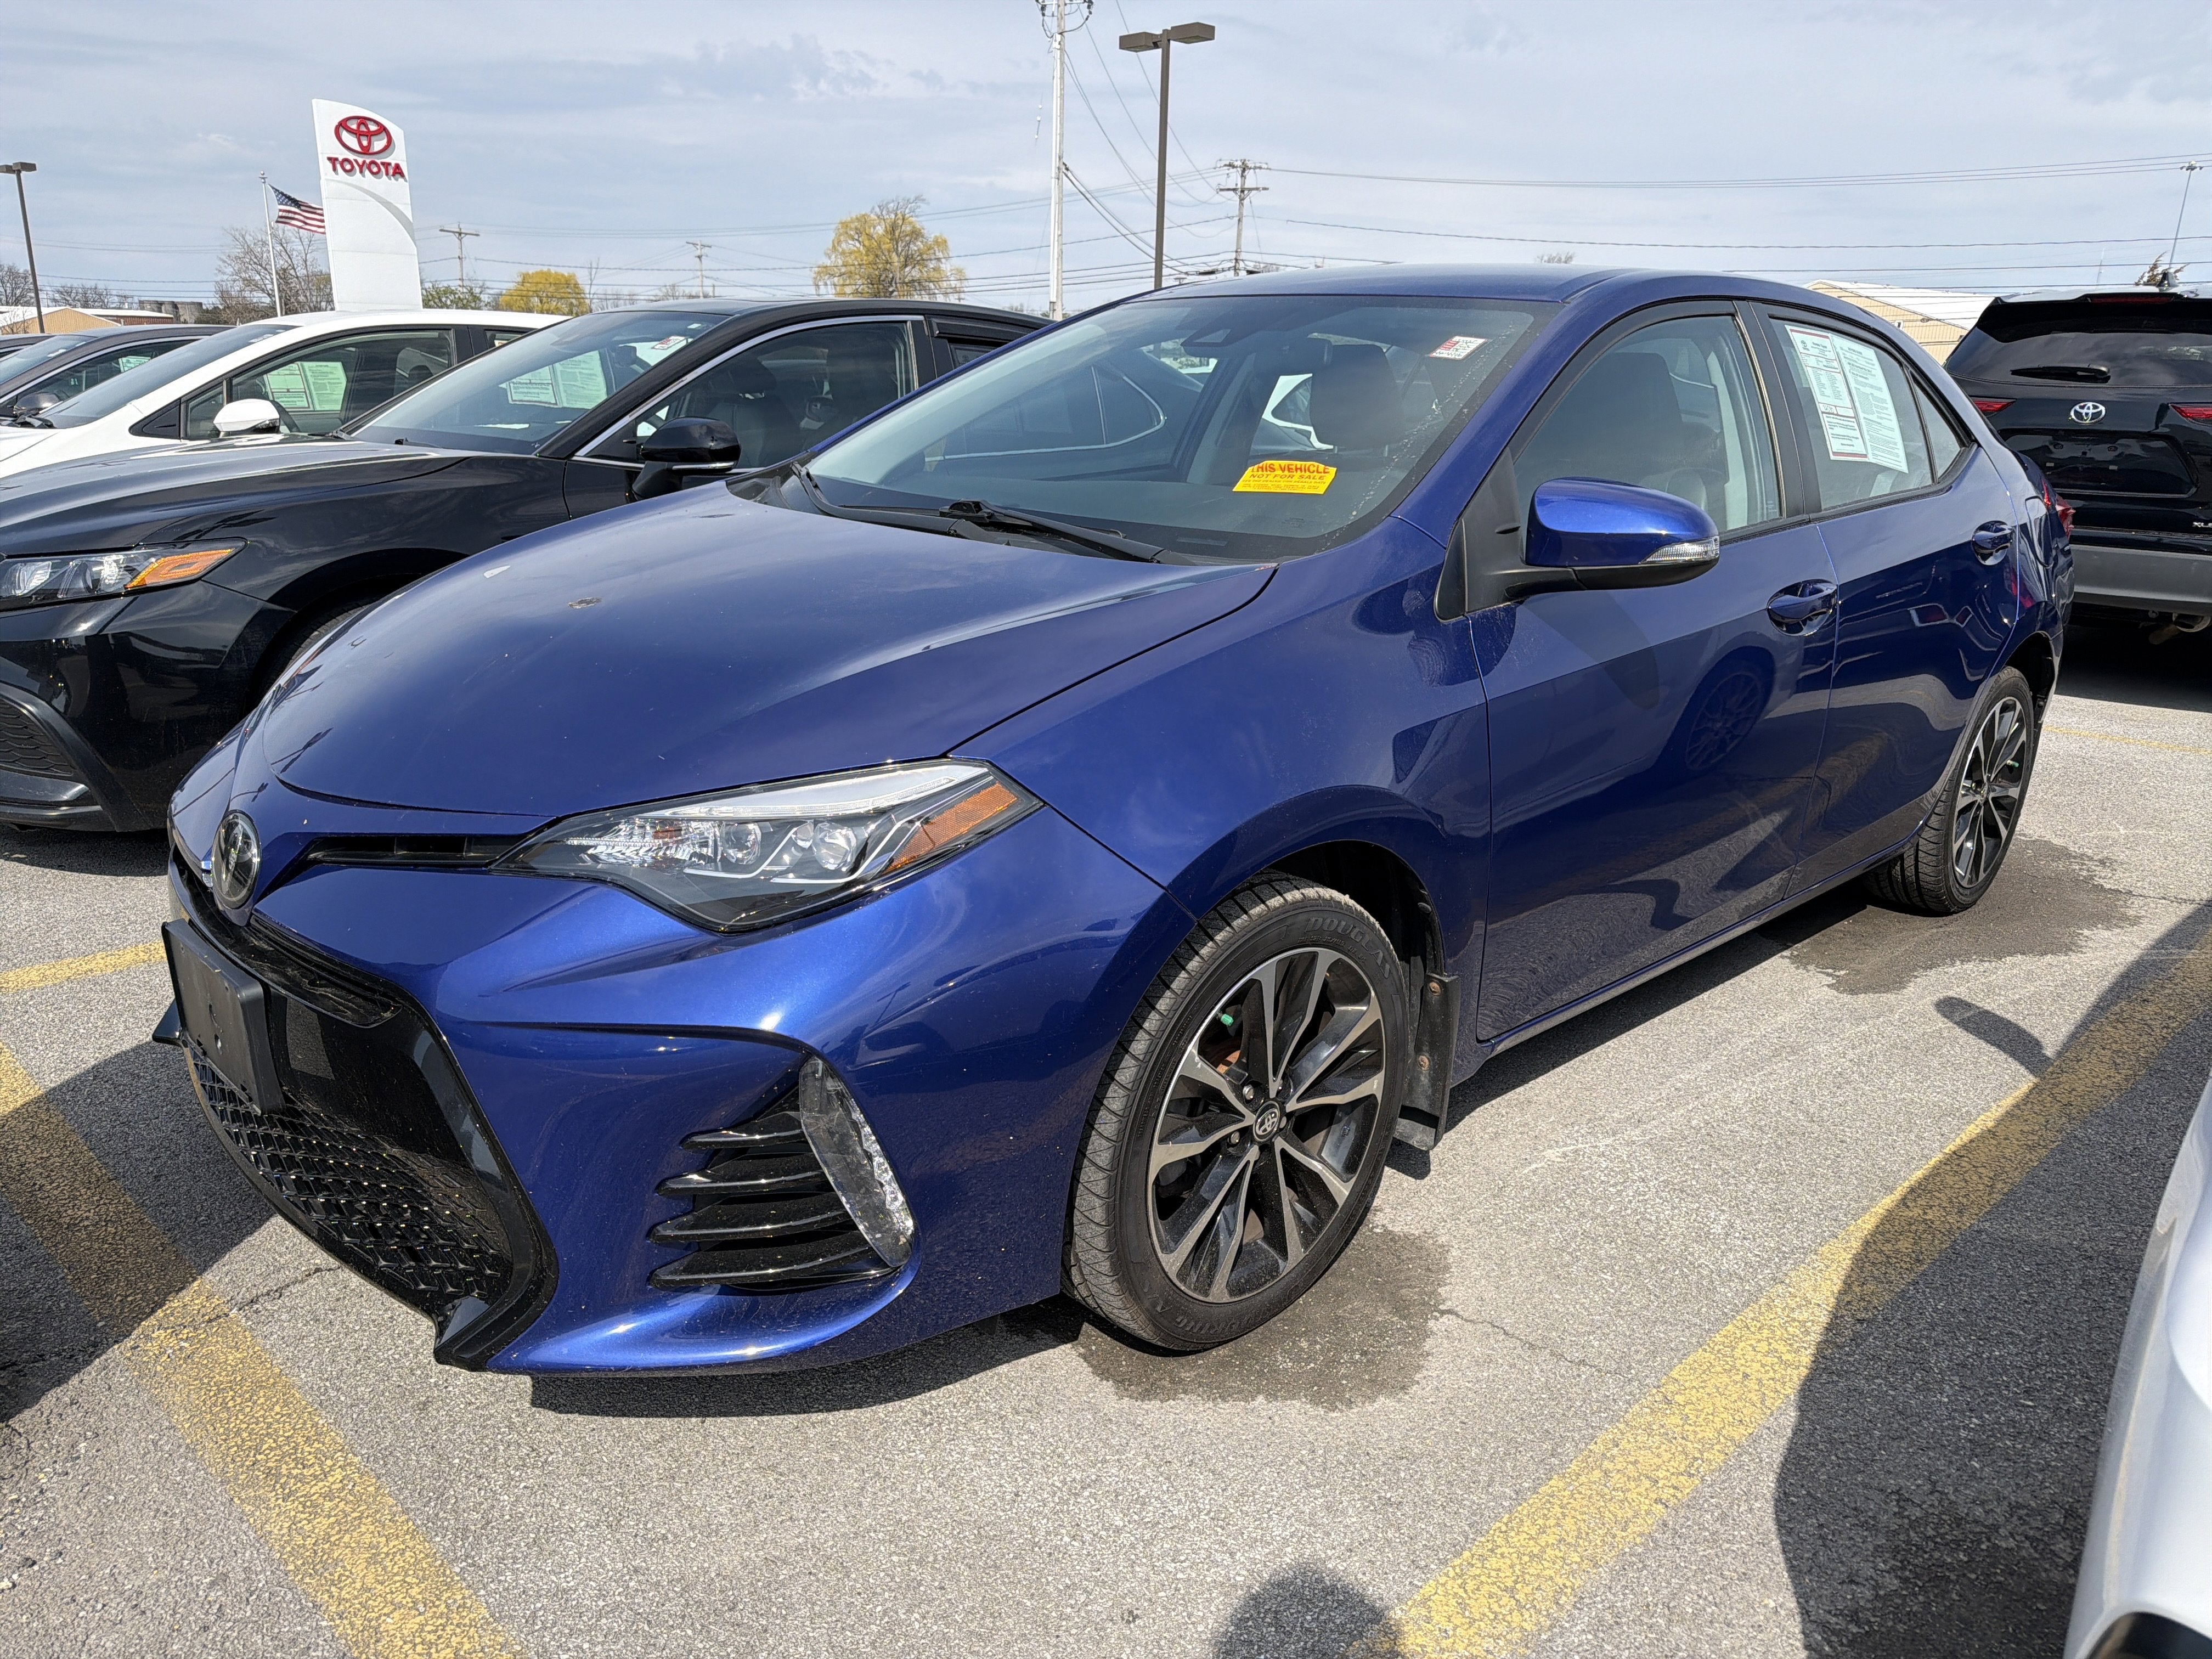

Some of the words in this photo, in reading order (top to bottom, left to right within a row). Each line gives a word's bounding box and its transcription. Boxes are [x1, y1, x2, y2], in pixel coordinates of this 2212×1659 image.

[327, 156, 405, 179] TOYOTA
[1278, 463, 1330, 474] VEHICLE
[1304, 917, 1391, 979] DOUGLAS
